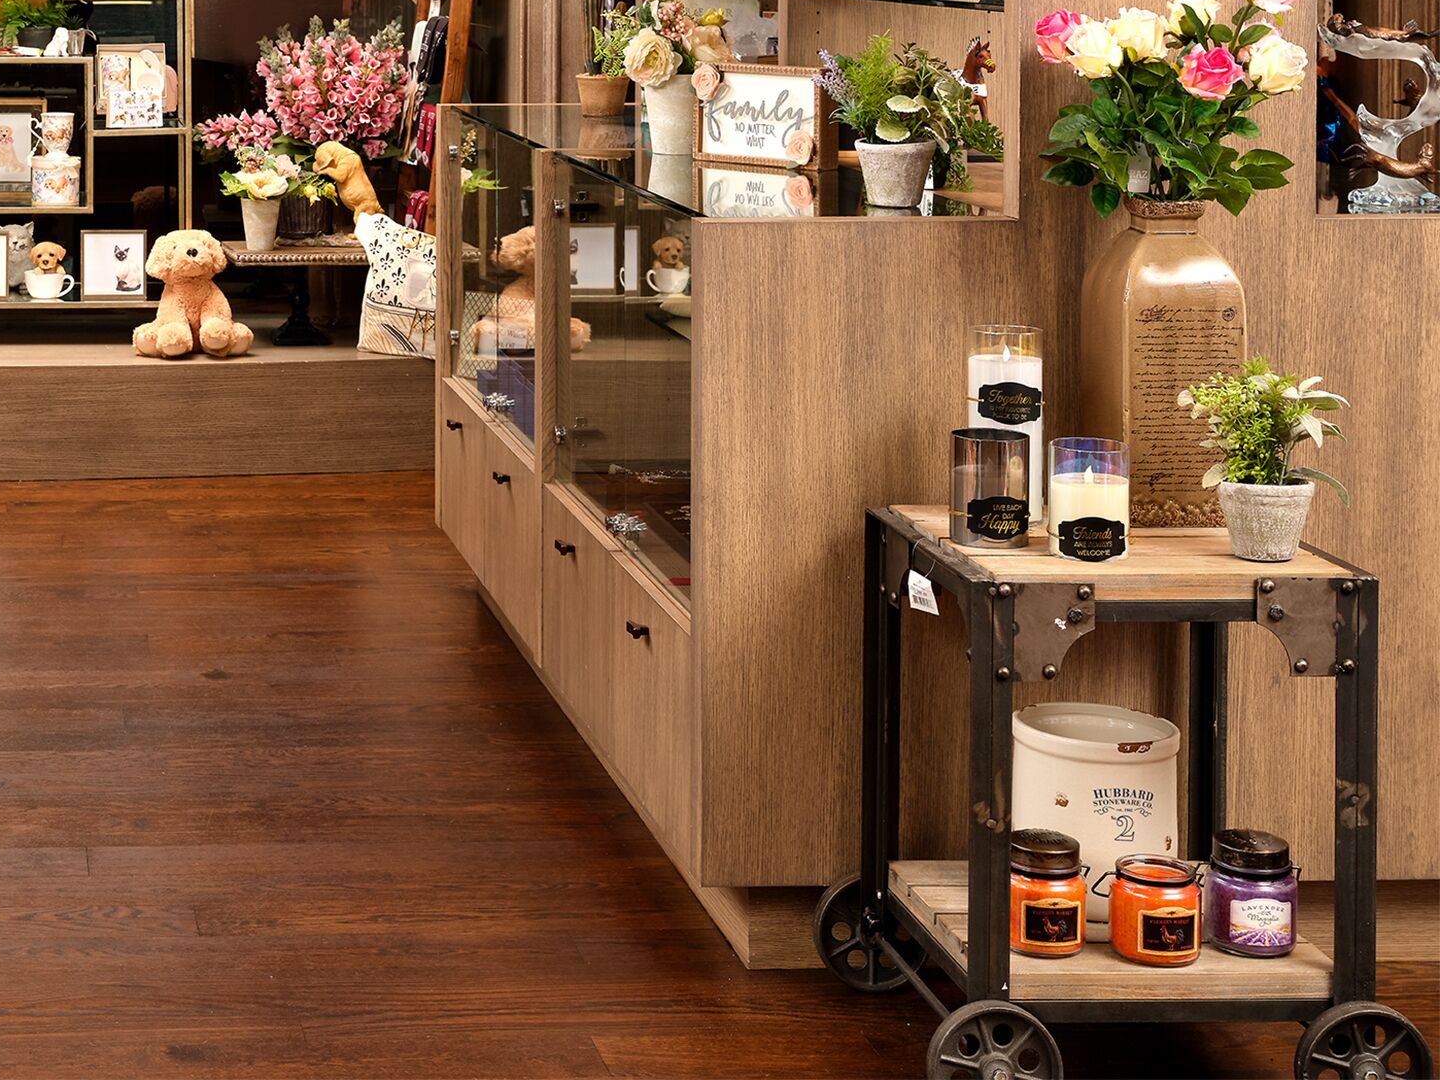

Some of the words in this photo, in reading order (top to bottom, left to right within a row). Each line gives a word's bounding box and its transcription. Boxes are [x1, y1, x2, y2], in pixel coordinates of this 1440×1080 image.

[705, 83, 814, 149] family
[735, 122, 746, 133] NO
[747, 123, 777, 138] MATTER
[746, 135, 766, 149] WHAT
[988, 389, 1032, 409] Together
[992, 504, 1006, 512] LIVE
[978, 512, 1021, 535] Happy
[1073, 526, 1113, 540] Friends
[1076, 549, 1111, 557] WELCOME
[1093, 788, 1154, 802] HUBBARD
[1093, 798, 1141, 807] STONEWARE
[1142, 801, 1153, 810] CO.
[1114, 814, 1136, 842] 2
[1241, 904, 1286, 913] LAVENDER
